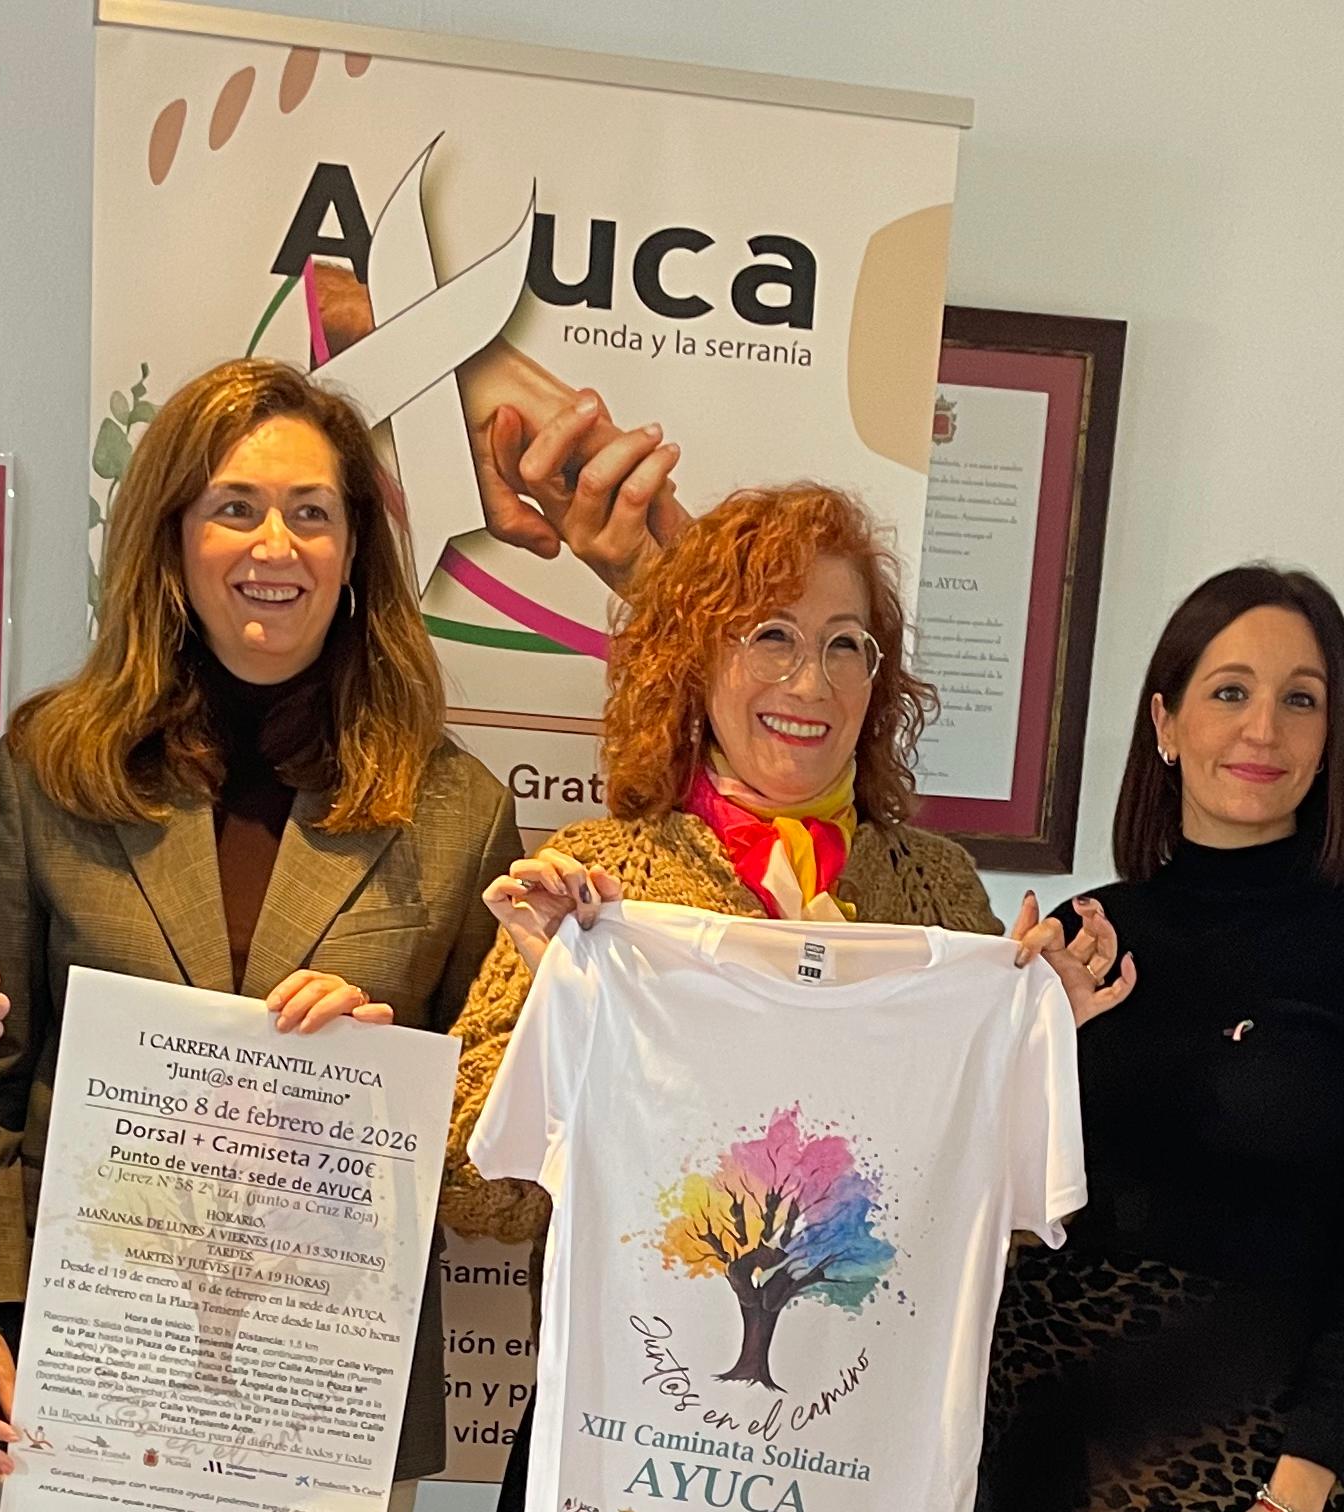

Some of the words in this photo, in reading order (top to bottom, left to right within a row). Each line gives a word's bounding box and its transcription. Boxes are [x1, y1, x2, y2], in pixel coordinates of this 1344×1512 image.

[563, 321, 643, 352] ronda
[652, 337, 667, 359] y
[675, 331, 696, 356] la
[704, 337, 813, 367] serranía
[138, 1030, 146, 1046] I
[149, 1032, 231, 1061] CARRERA
[234, 1047, 317, 1076] INFANTIL
[320, 1063, 384, 1088] AYUCA
[237, 1076, 258, 1090] en
[262, 1076, 278, 1094] el
[86, 1076, 189, 1117] Domingo
[193, 1096, 209, 1117] 8
[213, 1097, 241, 1122] de
[245, 1103, 325, 1137] febrero
[328, 1117, 356, 1142] de
[360, 1124, 418, 1153] 2026
[109, 1144, 160, 1167] Punto
[164, 1153, 186, 1171] de
[190, 1159, 243, 1181] venta:
[247, 1167, 287, 1189] sede
[290, 1175, 313, 1193] de
[315, 1180, 373, 1204] AYUCA
[115, 1117, 186, 1146] Dorsal
[191, 1132, 206, 1147] +
[211, 1133, 311, 1168] Camiseta
[316, 1152, 376, 1181] 7,00€
[60, 1258, 96, 1275] Desde
[97, 1264, 108, 1276] el
[112, 1267, 127, 1280] 19
[128, 1270, 143, 1282] de
[145, 1275, 179, 1289] enero
[180, 1278, 192, 1291] al
[197, 1281, 206, 1292] 6
[208, 1283, 223, 1296] de
[224, 1285, 267, 1303] febrero
[268, 1295, 283, 1306] en
[285, 1295, 297, 1308] la
[298, 1297, 324, 1313] sede
[324, 1302, 340, 1315] de
[125, 1246, 174, 1265] MARTES
[177, 1255, 187, 1267] Y
[187, 1256, 230, 1277] JUEVES
[254, 1268, 264, 1280] A
[267, 1270, 282, 1283] 19
[283, 1273, 331, 1295] HORAS)
[442, 1329, 496, 1355] ión
[482, 1383, 500, 1407] y
[453, 1420, 519, 1445] vida
[578, 1412, 625, 1443] XIII
[634, 1423, 755, 1464] Caminata
[762, 1444, 872, 1482] Solidaria
